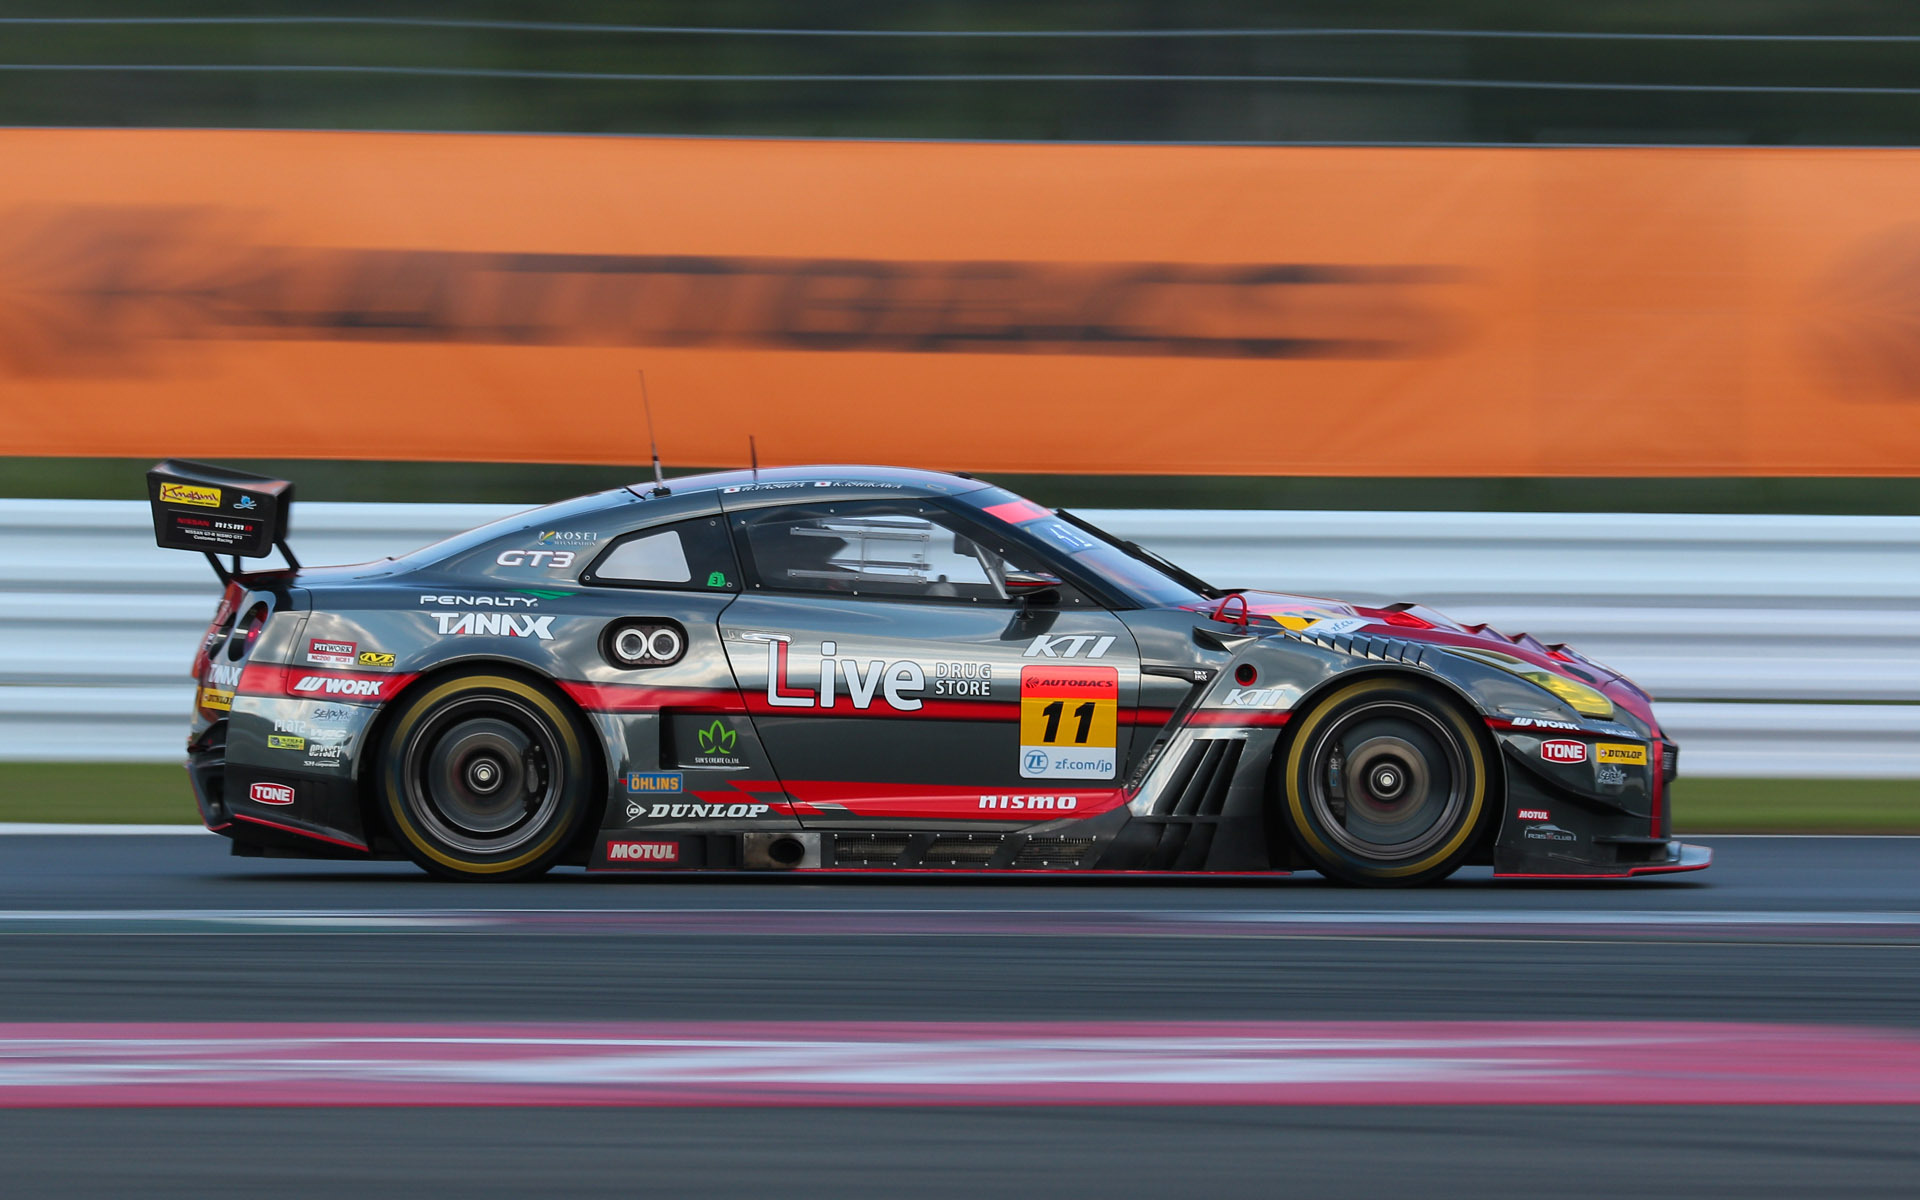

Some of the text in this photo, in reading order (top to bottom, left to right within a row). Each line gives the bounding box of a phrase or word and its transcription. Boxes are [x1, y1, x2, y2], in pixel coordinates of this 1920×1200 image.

[177, 517, 253, 532] NISSAN nismo
[193, 534, 216, 542] Customer
[555, 531, 597, 541] KOSEI
[496, 550, 576, 568] GT3
[712, 576, 718, 584] 3
[420, 595, 537, 607] PENALTY
[430, 612, 557, 640] TANAX
[1022, 635, 1117, 659] KTI
[766, 640, 927, 711] Live
[935, 662, 992, 680] DRUG
[324, 678, 384, 696] WORK
[934, 679, 992, 697] STORE
[1040, 678, 1114, 688] AUTOBACS
[1222, 688, 1287, 706] KTI
[1042, 700, 1096, 744] 11
[1533, 719, 1580, 731] WORK
[1545, 743, 1583, 759] TONE
[1608, 749, 1643, 759] DUNLOP
[1026, 753, 1113, 773] ZF zf.com/jp
[631, 773, 680, 791] ÖHLINS
[254, 785, 291, 801] TONE
[978, 794, 1078, 810] nismo
[648, 803, 769, 818] DUNLOP
[1519, 810, 1549, 820] MOTUL
[609, 843, 676, 860] MOTUL
